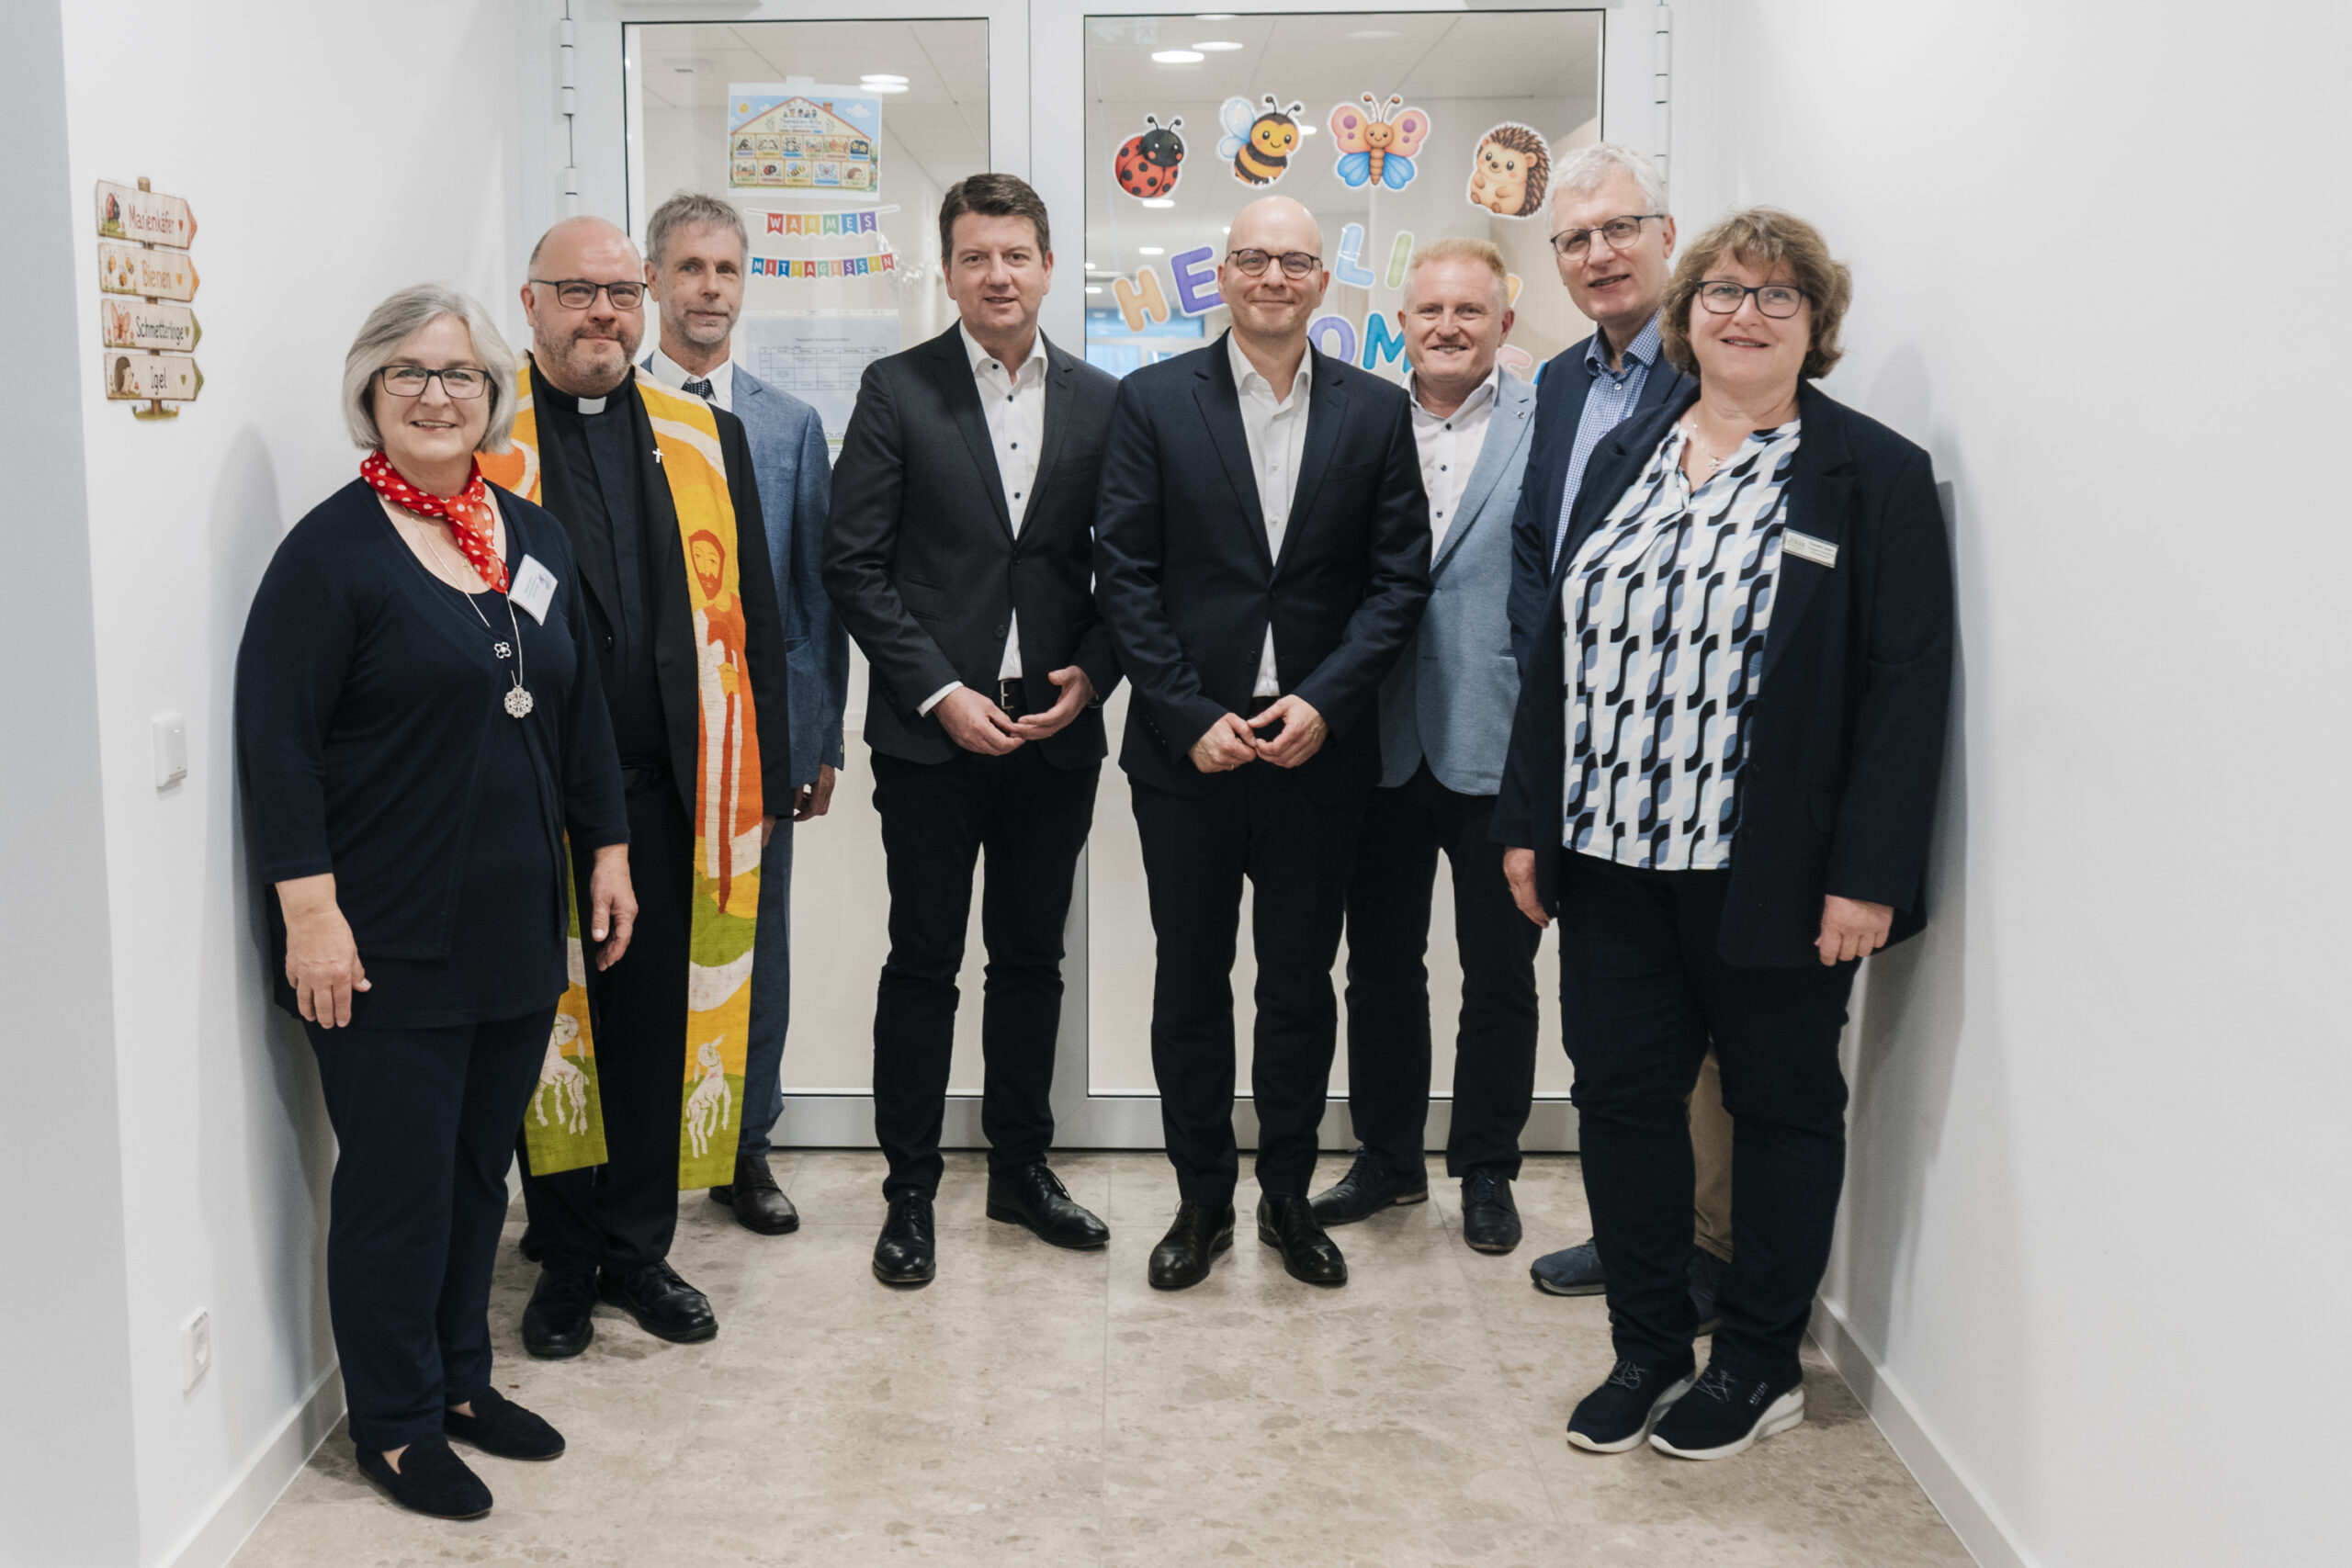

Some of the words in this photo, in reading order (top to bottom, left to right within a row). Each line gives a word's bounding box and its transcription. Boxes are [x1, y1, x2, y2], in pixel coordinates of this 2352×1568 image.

[129, 203, 175, 234] Marienkäfer
[770, 215, 872, 230] WARMES
[141, 260, 171, 289] Bienen
[754, 257, 892, 274] MITTAGESSEN
[135, 315, 184, 345] Schmetterlinge
[150, 366, 167, 395] Igel
